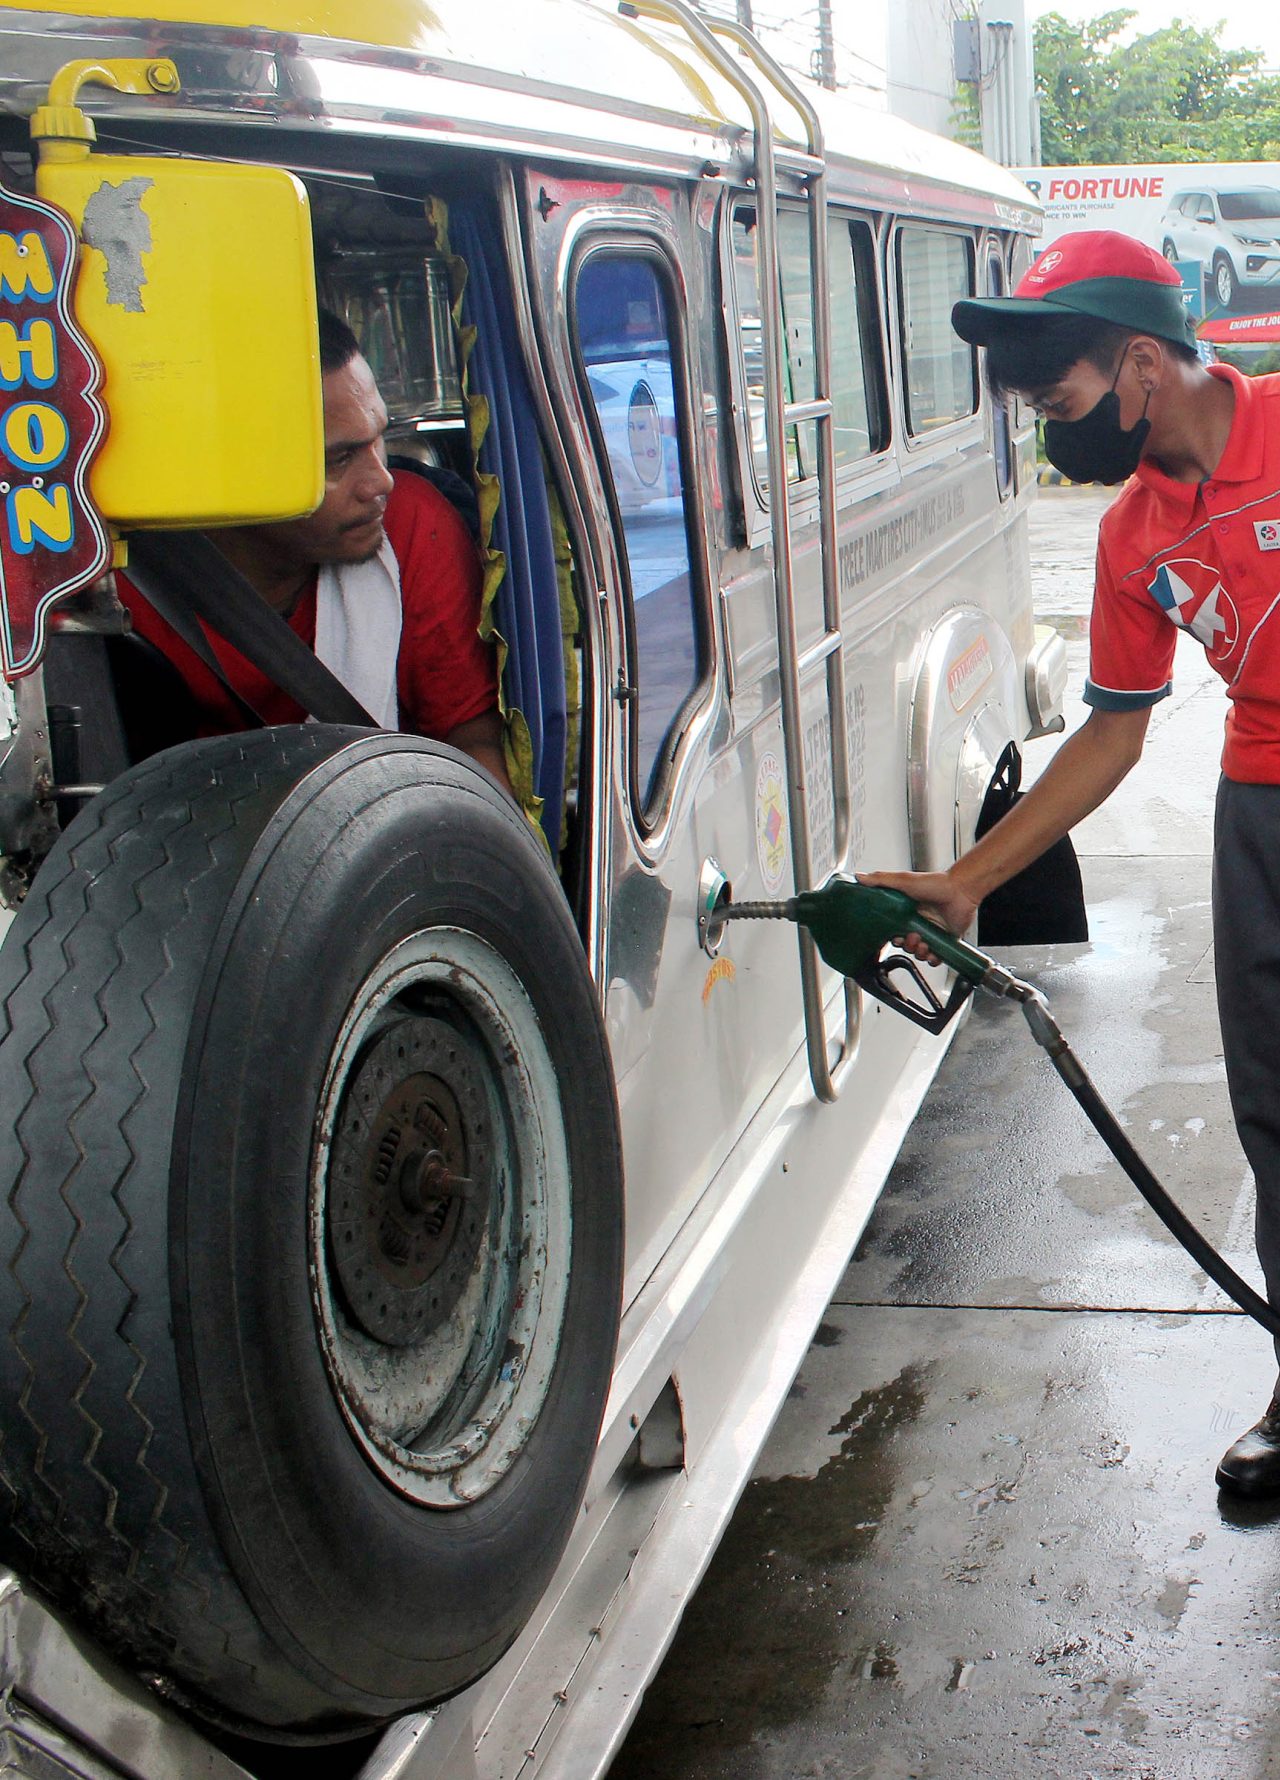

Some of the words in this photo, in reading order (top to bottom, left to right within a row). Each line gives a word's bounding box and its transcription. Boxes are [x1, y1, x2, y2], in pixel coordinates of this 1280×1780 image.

[1048, 177, 1165, 201] FORTUNE
[1079, 202, 1115, 211] PURCHASE
[1061, 212, 1071, 220] TO
[1072, 211, 1087, 219] WIN
[1229, 319, 1253, 331] ENJOY
[1252, 316, 1268, 328] THE
[838, 537, 866, 593] TRECE
